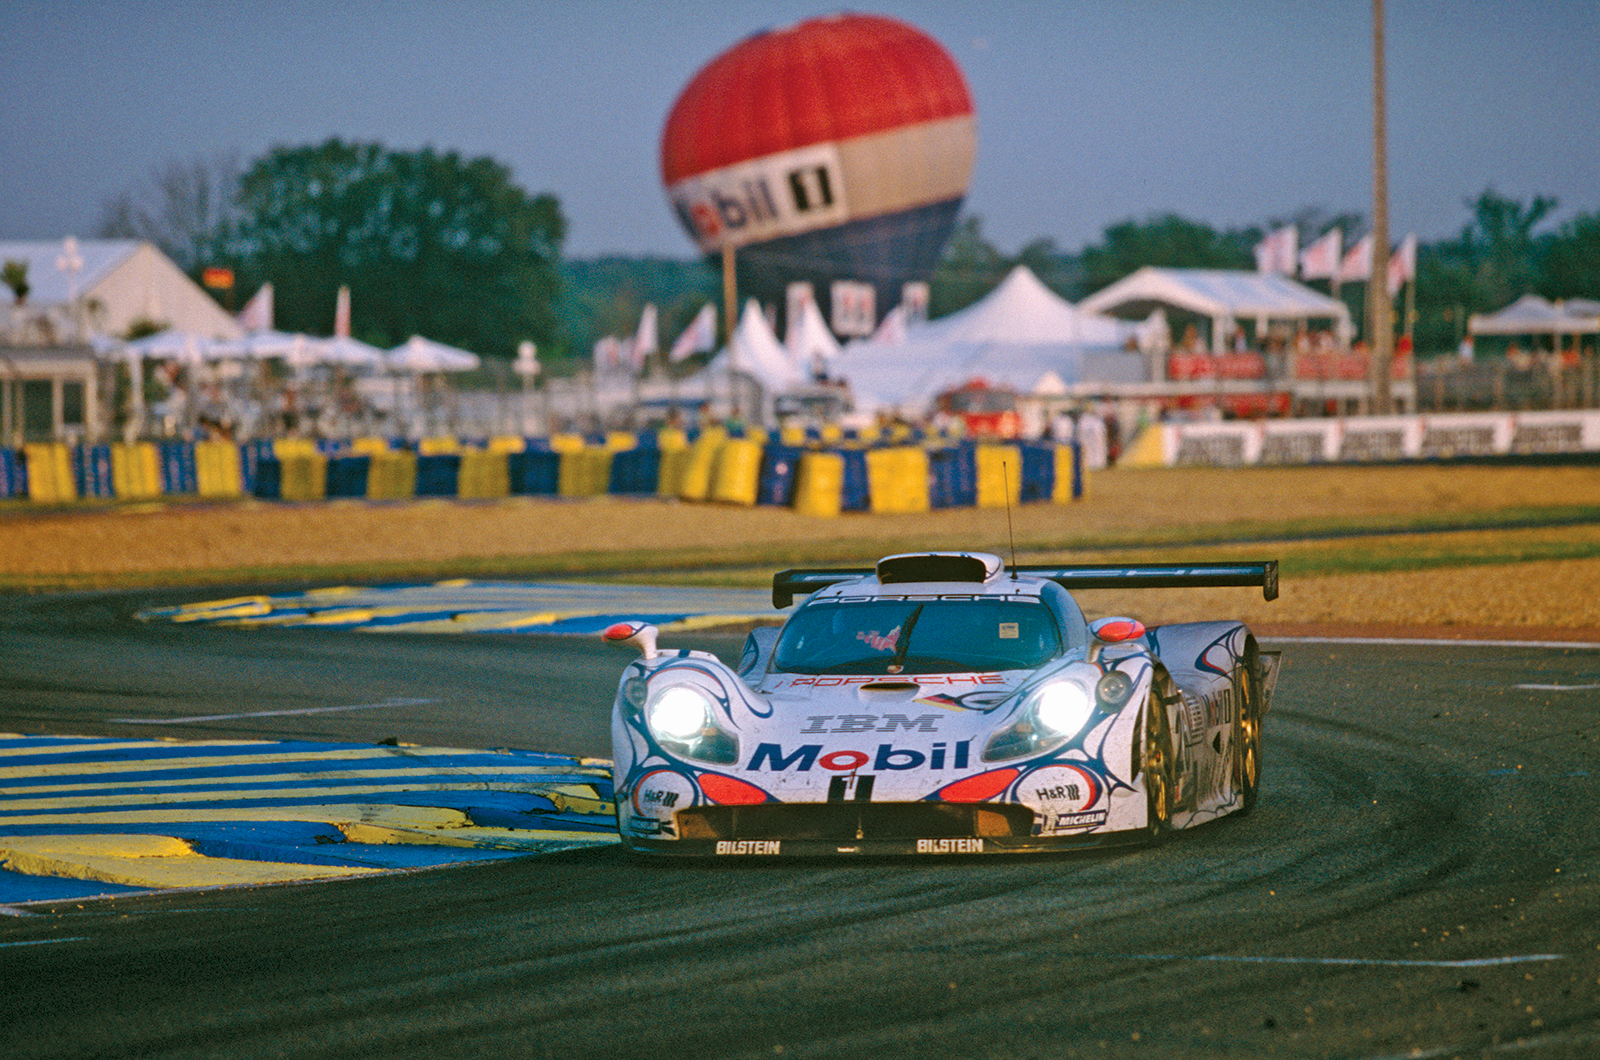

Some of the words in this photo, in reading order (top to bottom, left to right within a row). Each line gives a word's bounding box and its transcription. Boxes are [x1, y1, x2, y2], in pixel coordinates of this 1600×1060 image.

[790, 674, 1006, 689] PORSCHE
[800, 714, 944, 734] IBM
[746, 740, 970, 771] Mobil
[1036, 786, 1065, 801] H&R
[1059, 812, 1106, 826] MICHELIN
[716, 840, 780, 855] BILSTEIN
[917, 839, 983, 853] BILSTEIN
